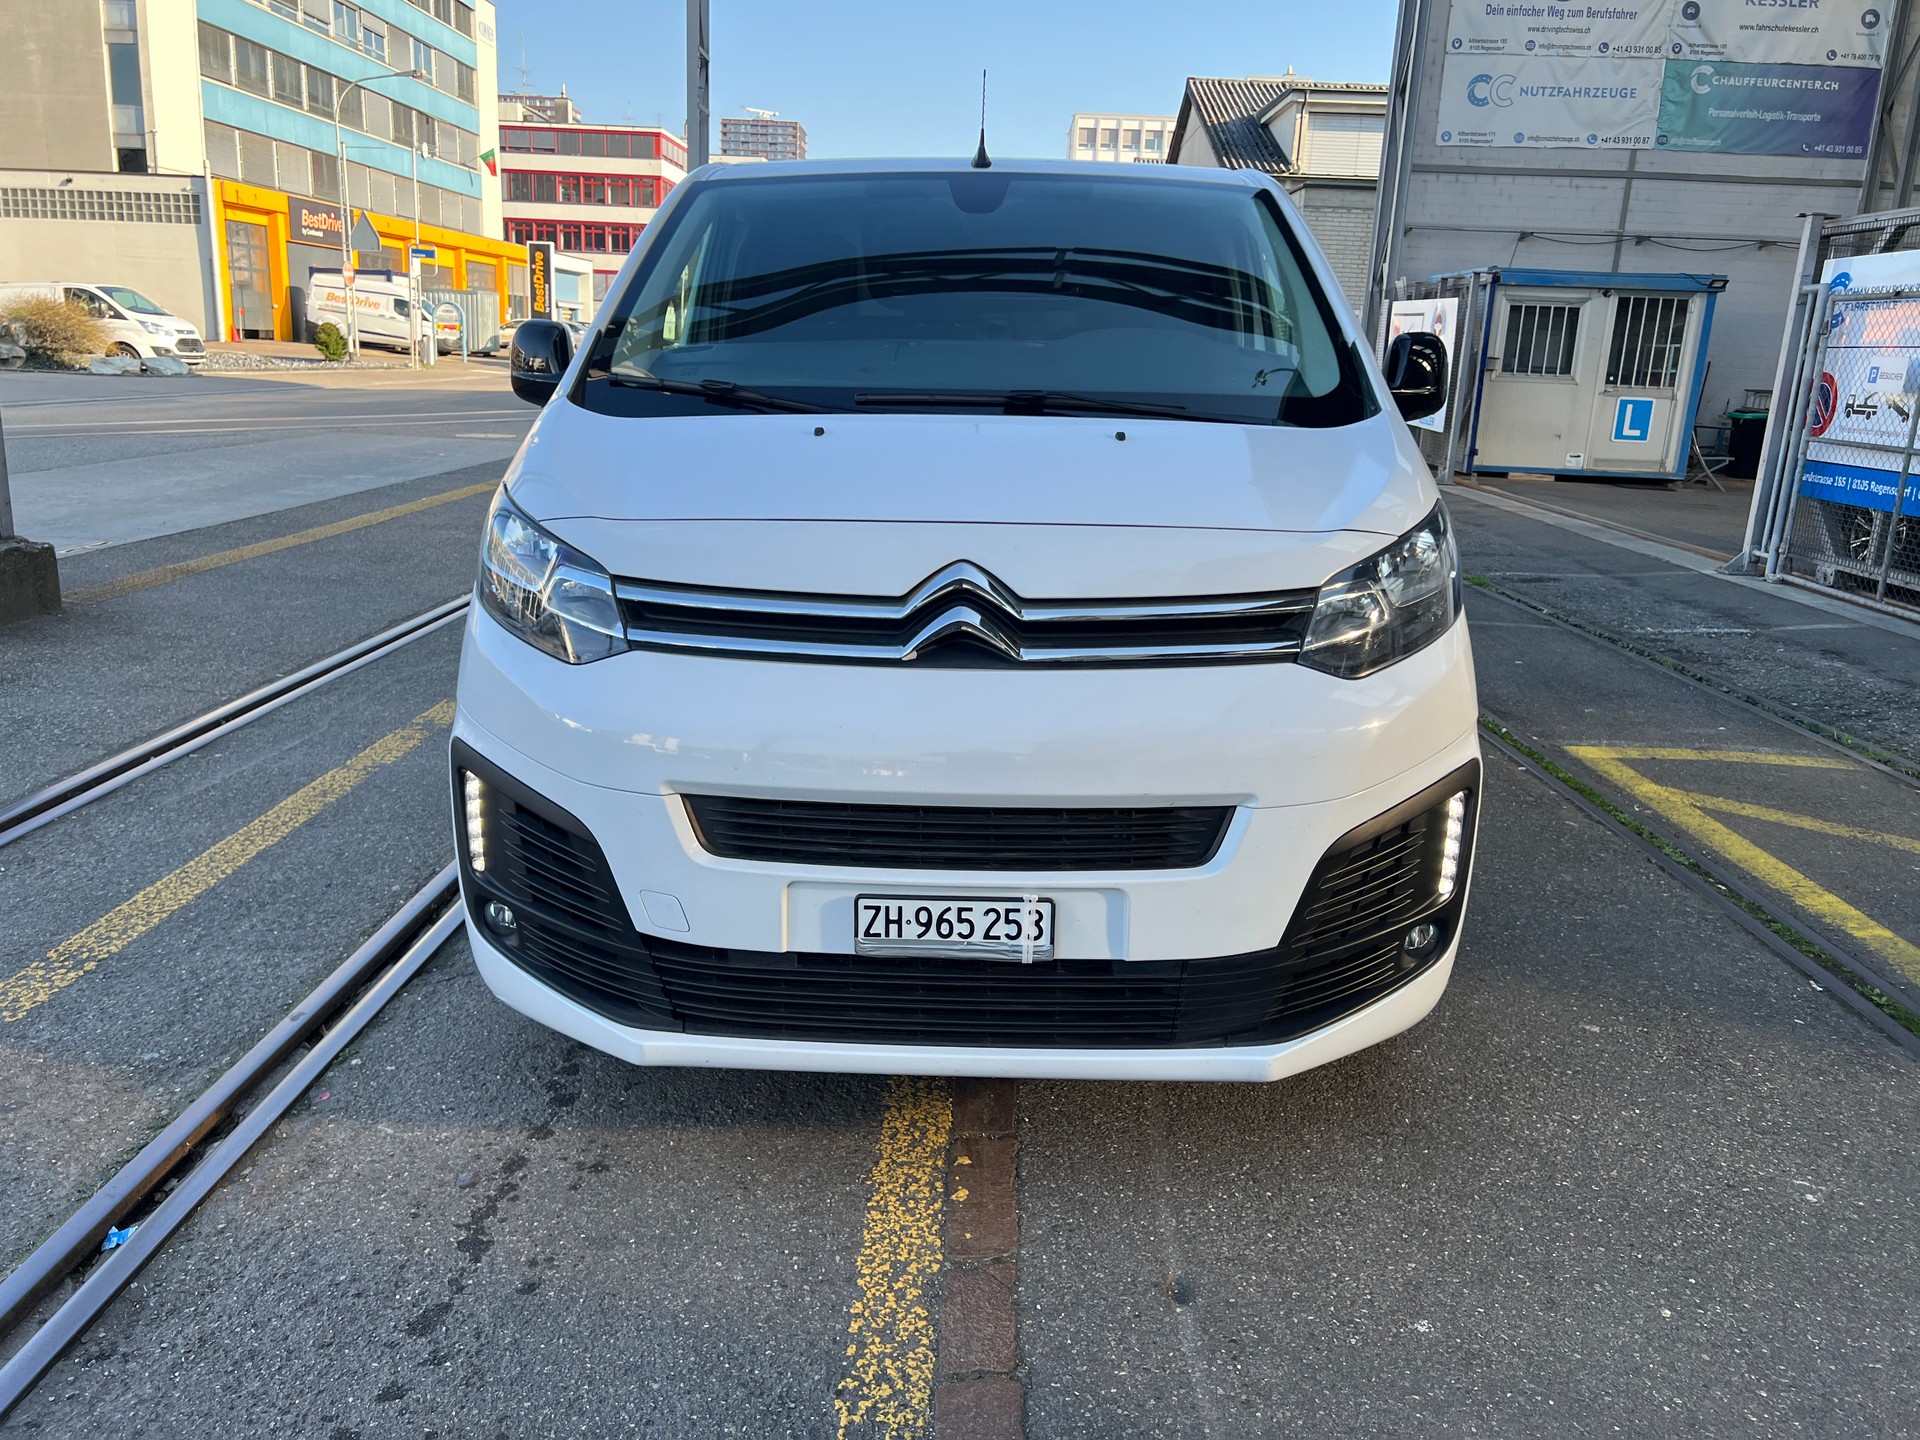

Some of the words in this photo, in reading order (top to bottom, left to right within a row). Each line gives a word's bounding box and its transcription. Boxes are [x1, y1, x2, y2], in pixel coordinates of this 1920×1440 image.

[1485, 3, 1504, 16] Dein
[1506, 4, 1545, 17] einfacher
[1547, 6, 1565, 20] Weg
[1567, 8, 1584, 18] zum
[1586, 6, 1638, 20] Berufsfahrer
[1527, 25, 1591, 35] www.drivingtechswiss.ch
[1739, 24, 1819, 33] www.fahrschulekessler.ch
[1711, 75, 1840, 91] CHAUFFEURCENTER.CH
[1519, 86, 1638, 99] NUTZFAHRZEUGE
[1707, 107, 1821, 123] Personalverleih-Logistik-Transporte
[1642, 137, 1650, 145] 87
[1825, 144, 1833, 152] 43
[1834, 145, 1845, 153] 931
[1846, 145, 1854, 153] 00
[301, 208, 343, 233] BestDrive
[531, 251, 545, 313] BestDrive
[326, 292, 381, 309] BesDrive
[1622, 403, 1641, 437] L
[1802, 471, 1834, 485] ardstrasse
[1851, 478, 1870, 491] 8105
[1869, 481, 1912, 497] Regensrf
